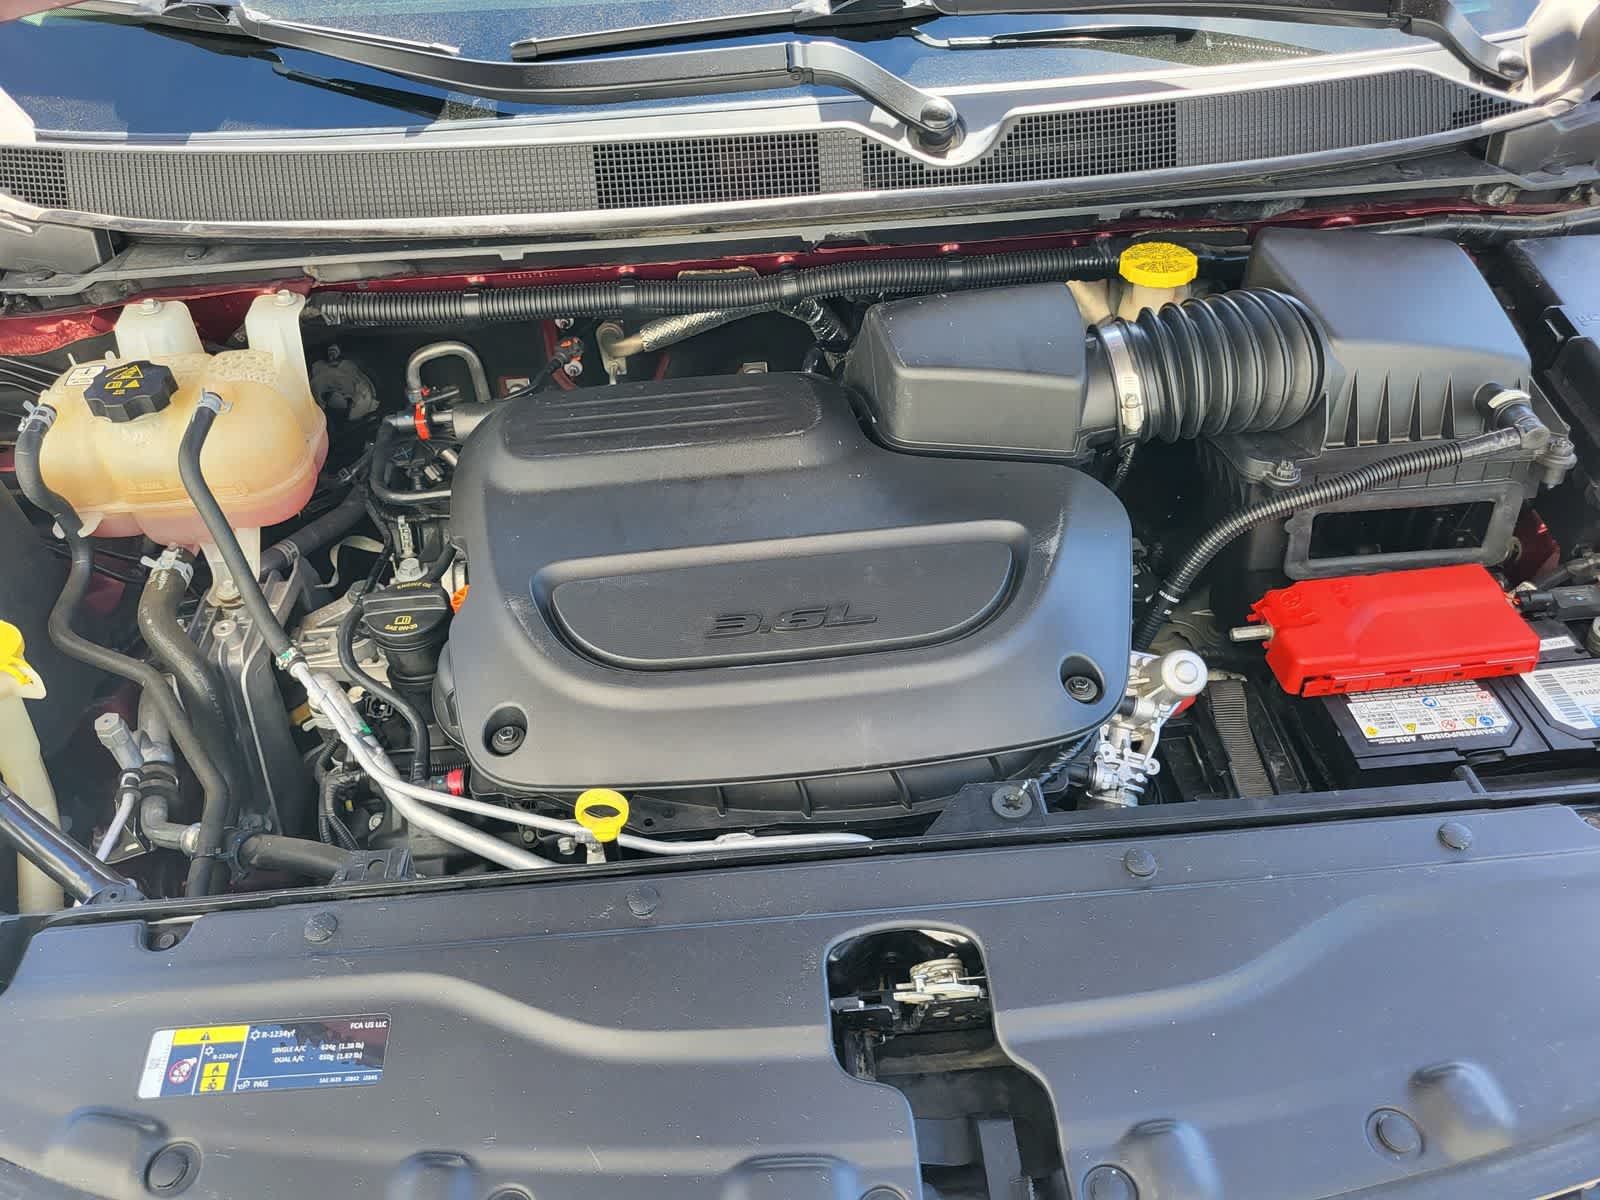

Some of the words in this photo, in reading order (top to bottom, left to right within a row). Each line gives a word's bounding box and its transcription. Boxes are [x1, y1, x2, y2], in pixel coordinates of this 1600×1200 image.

[704, 600, 878, 640] 3.6L
[350, 1022, 363, 1030] FCA
[364, 1021, 375, 1029] US
[375, 1020, 387, 1028] LLC
[261, 1030, 296, 1039] R-1234yf
[253, 1080, 269, 1088] PAG
